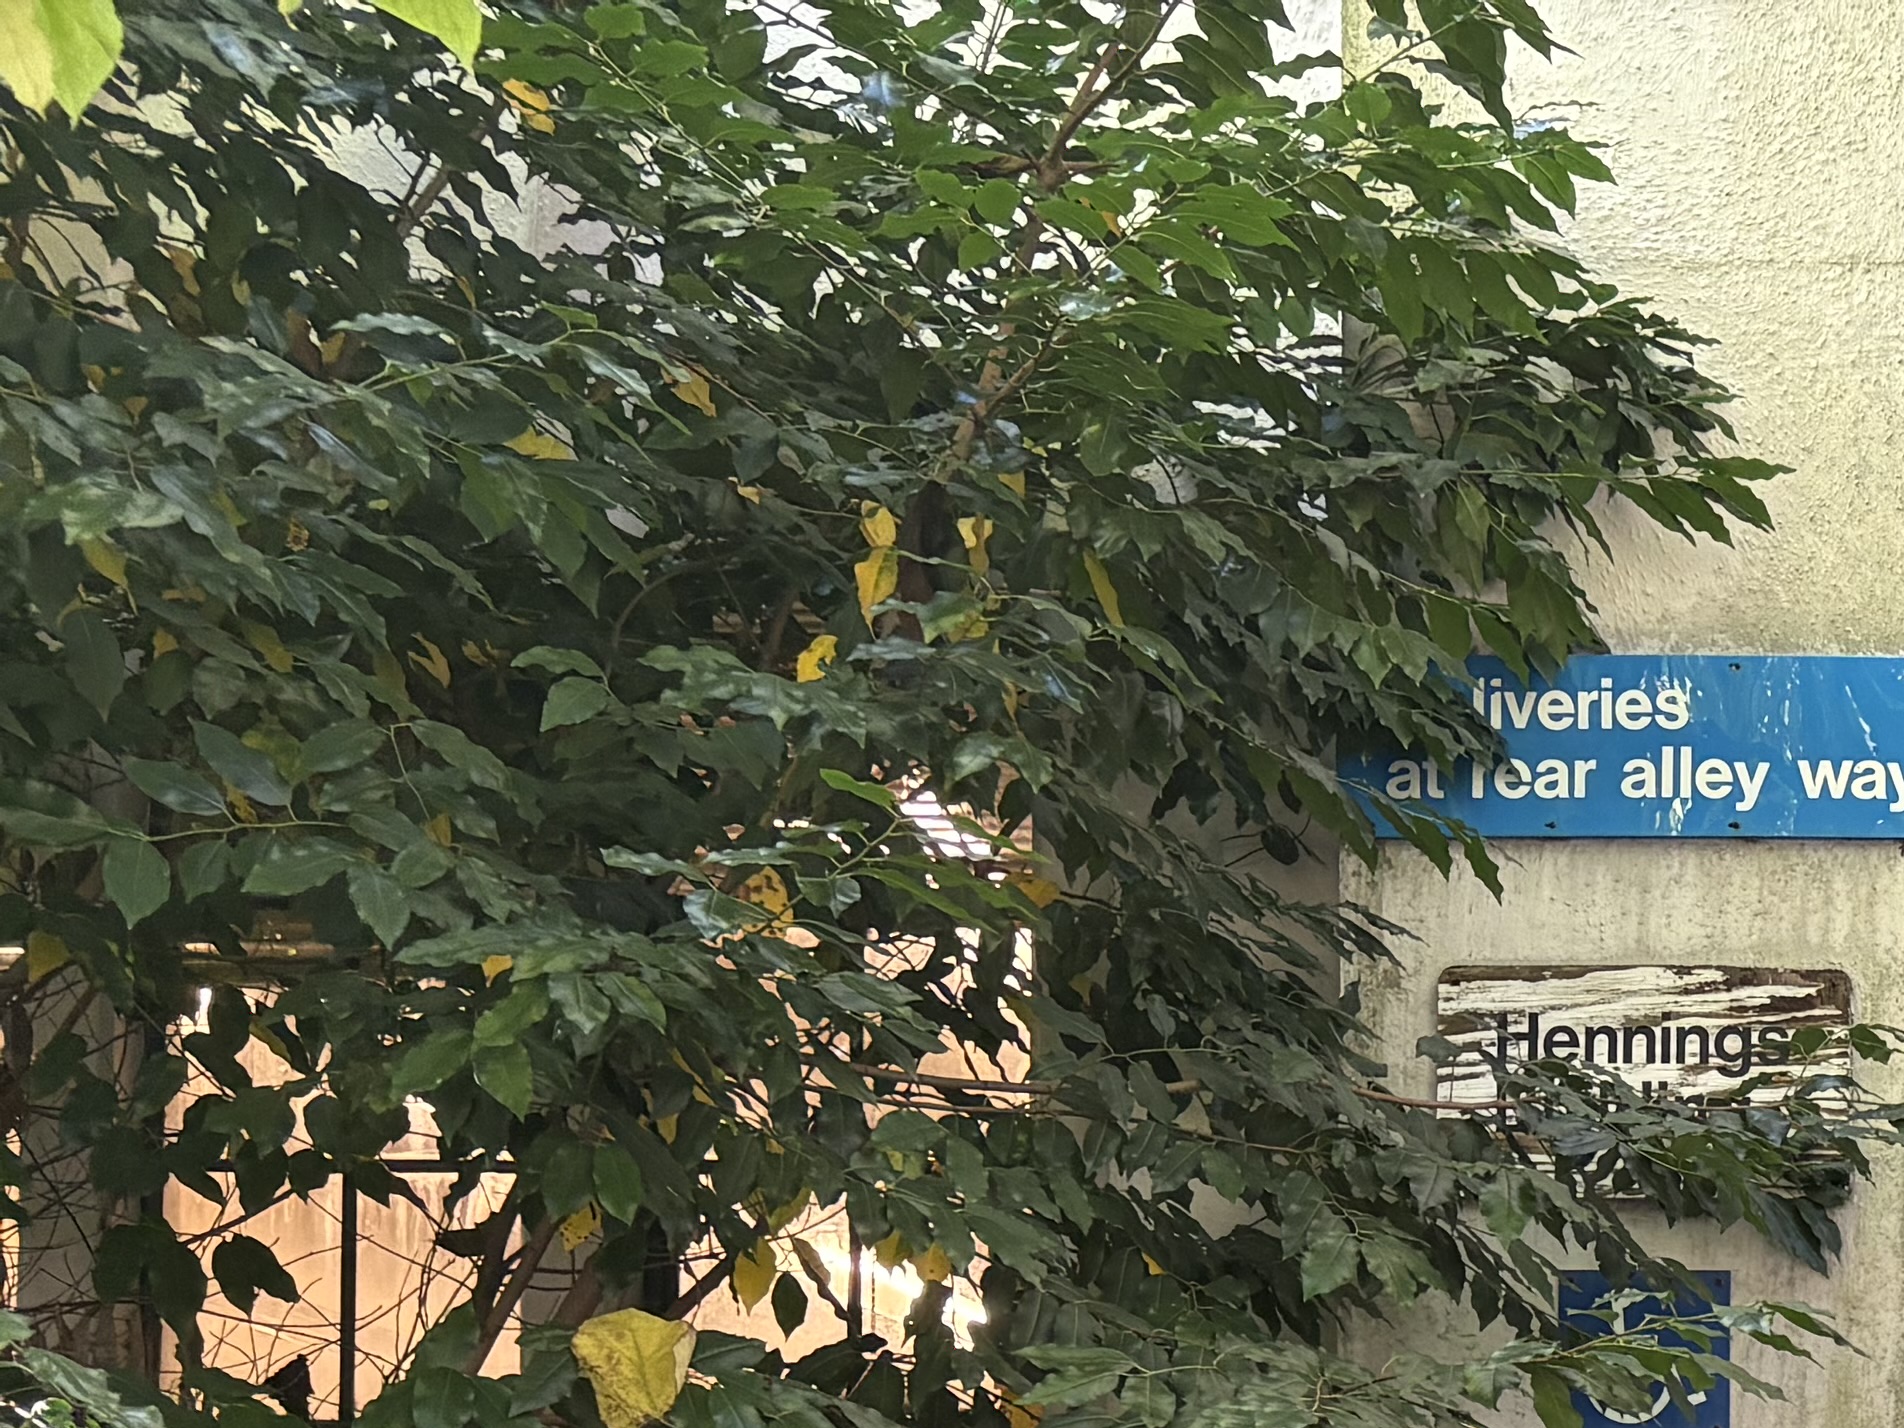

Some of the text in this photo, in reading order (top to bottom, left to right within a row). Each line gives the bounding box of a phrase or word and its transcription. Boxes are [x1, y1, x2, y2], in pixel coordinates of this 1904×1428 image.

[1473, 677, 1690, 731] liveries
[1385, 757, 1445, 800] at
[1471, 756, 1597, 800] rear
[1620, 745, 1771, 812] alley
[1496, 1011, 1791, 1078] Hennings
